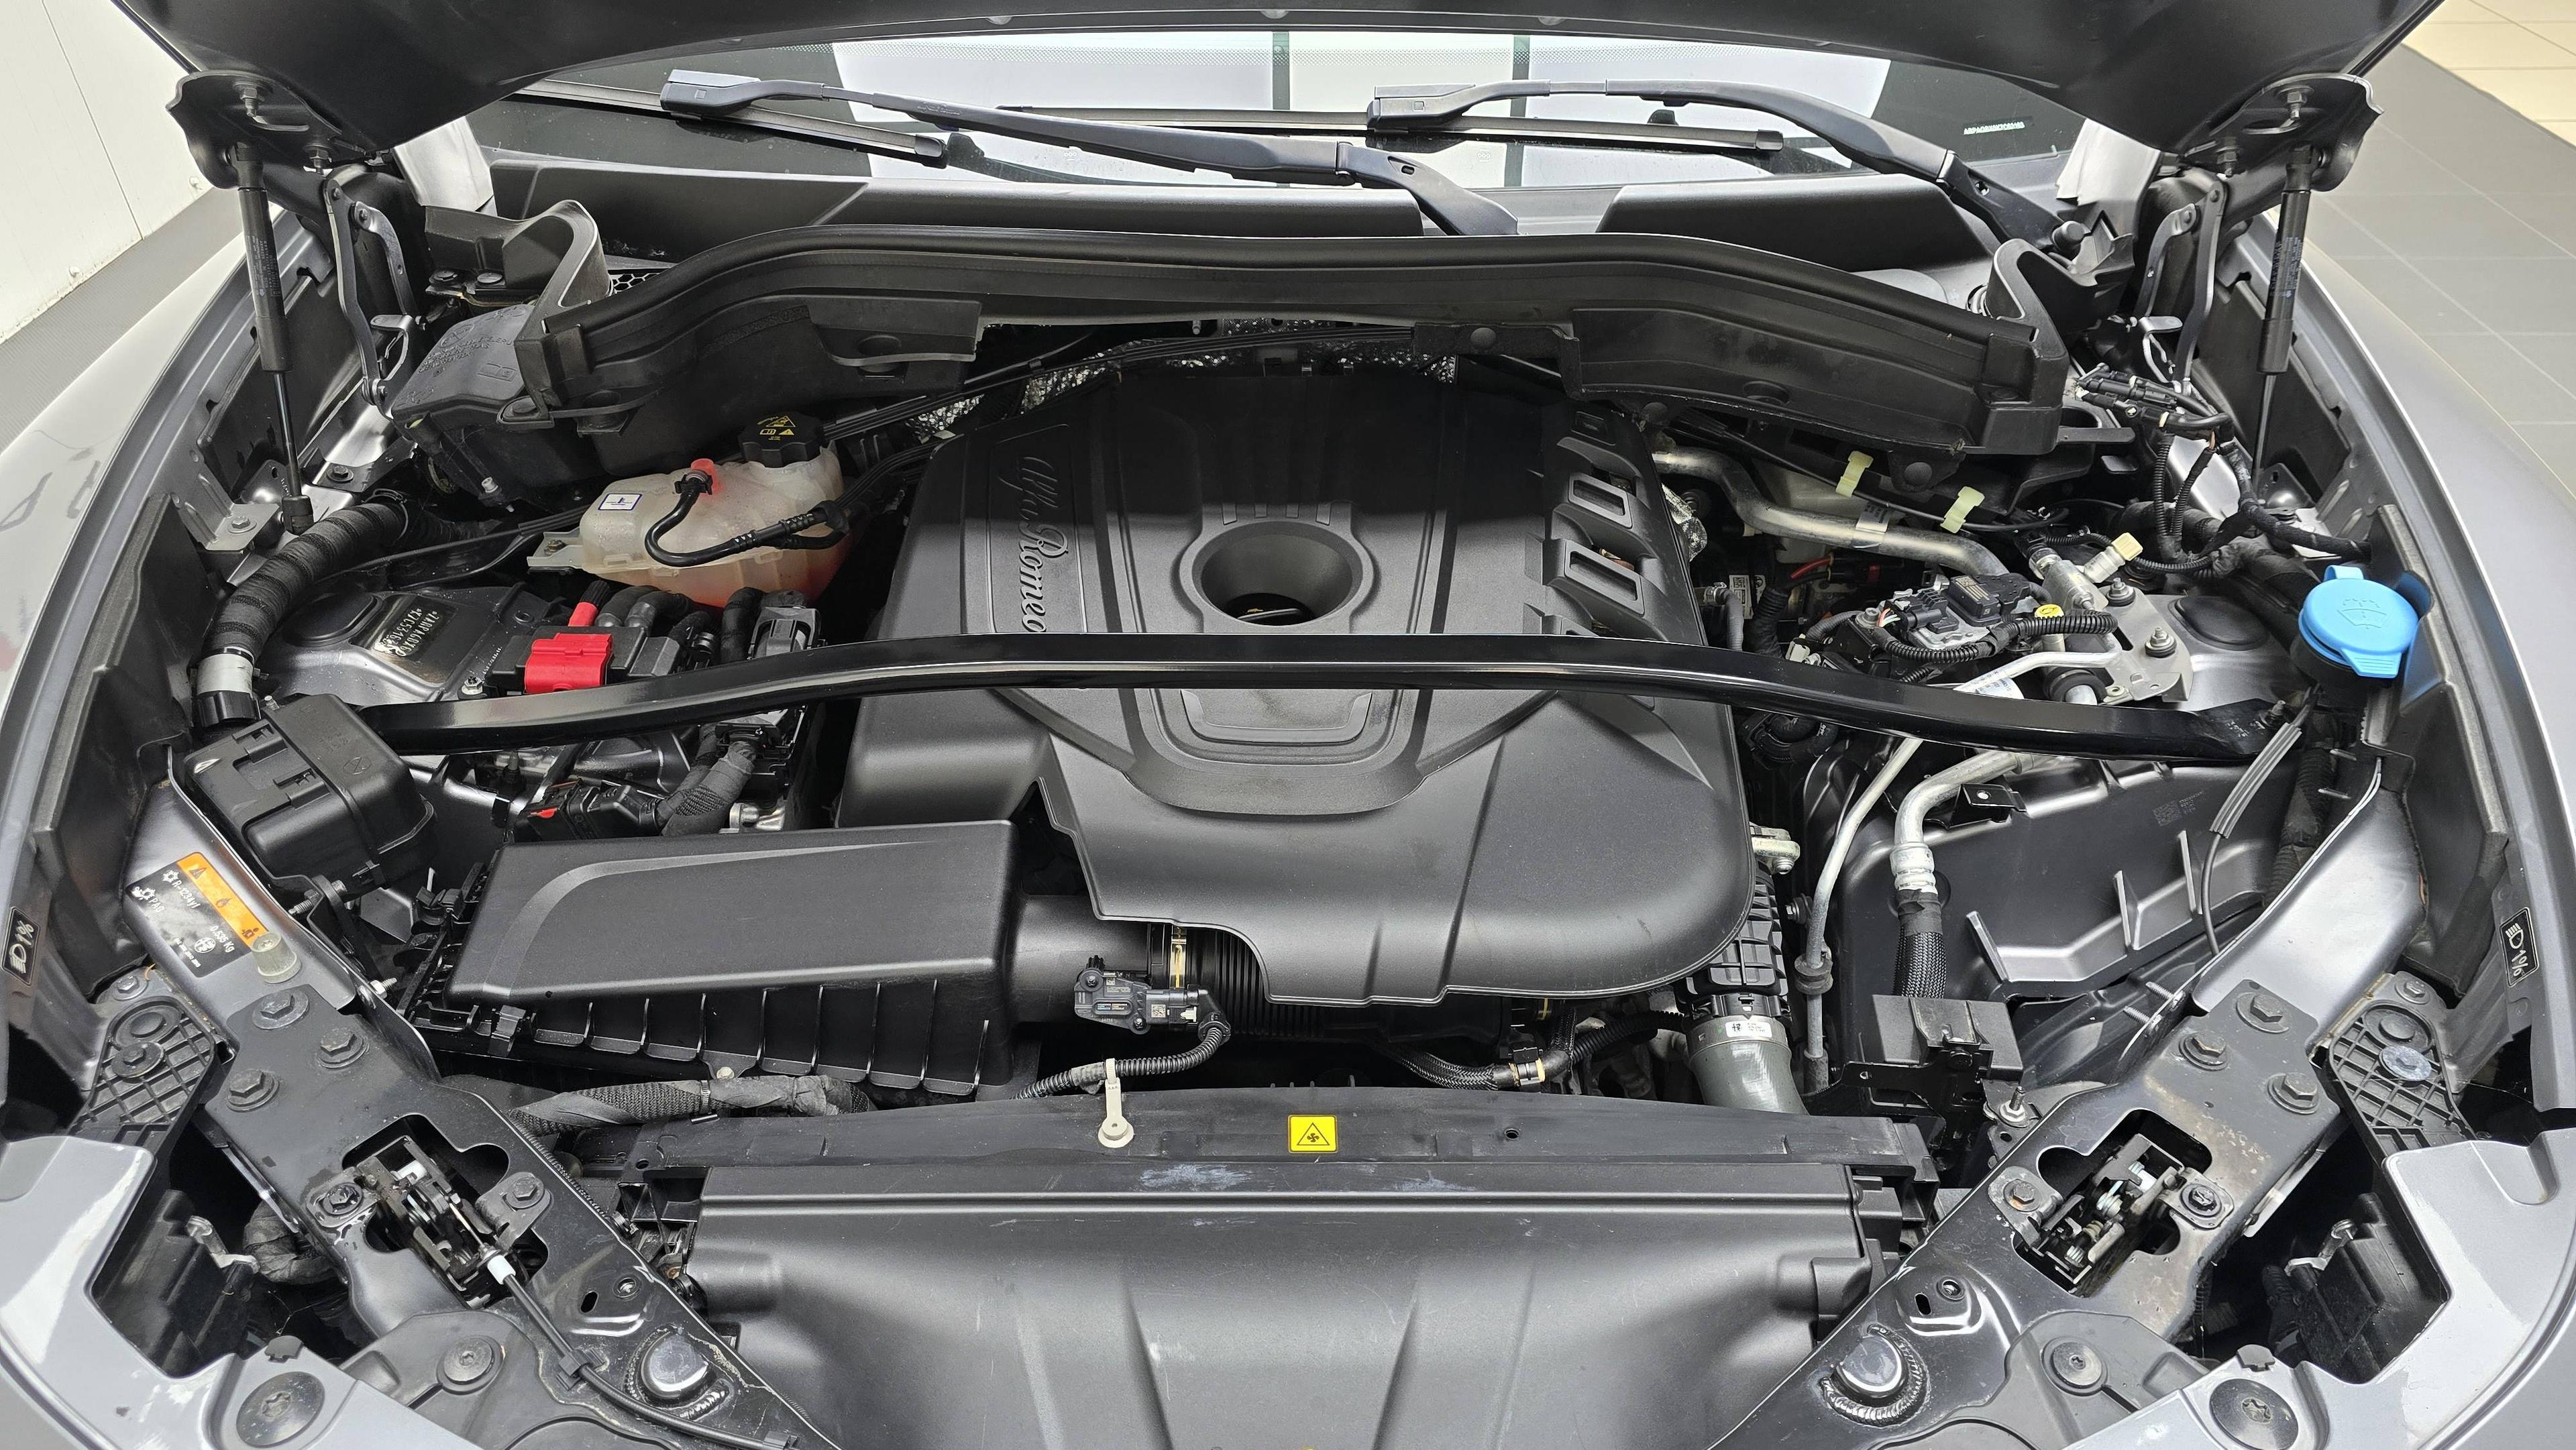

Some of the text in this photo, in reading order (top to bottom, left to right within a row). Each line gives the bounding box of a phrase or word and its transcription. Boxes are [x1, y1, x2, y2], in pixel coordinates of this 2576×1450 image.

[998, 456, 1069, 632] Alfa Romeo
[148, 897, 165, 913] PAG
[225, 940, 235, 953] Kg
[2511, 950, 2528, 977] 1%
